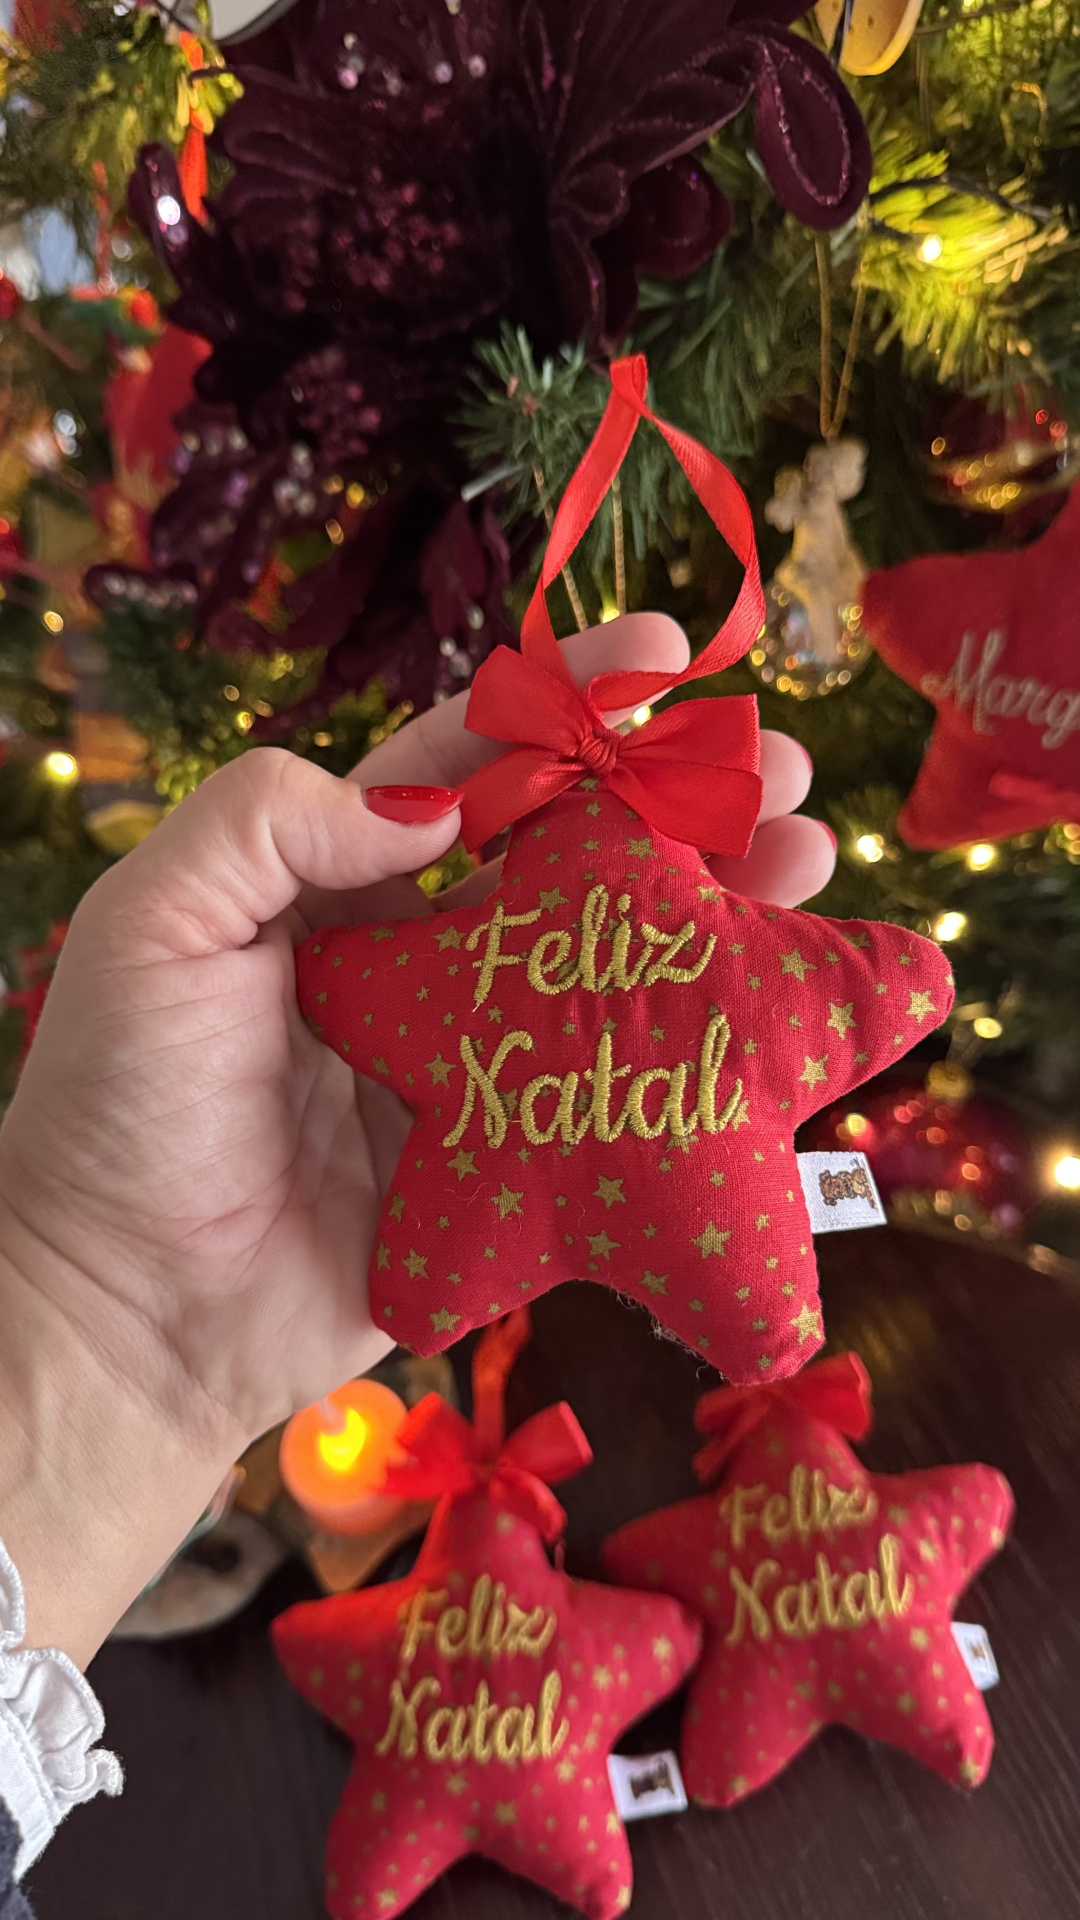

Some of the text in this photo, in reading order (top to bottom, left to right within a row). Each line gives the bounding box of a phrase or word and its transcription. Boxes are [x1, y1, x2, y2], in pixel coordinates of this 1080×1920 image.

[465, 884, 717, 1011] Feliz
[442, 1013, 743, 1149] Natal
[719, 1463, 878, 1550] Feliz
[397, 1572, 558, 1666] Feliz
[724, 1532, 915, 1646] Natal
[375, 1668, 571, 1764] Natal
